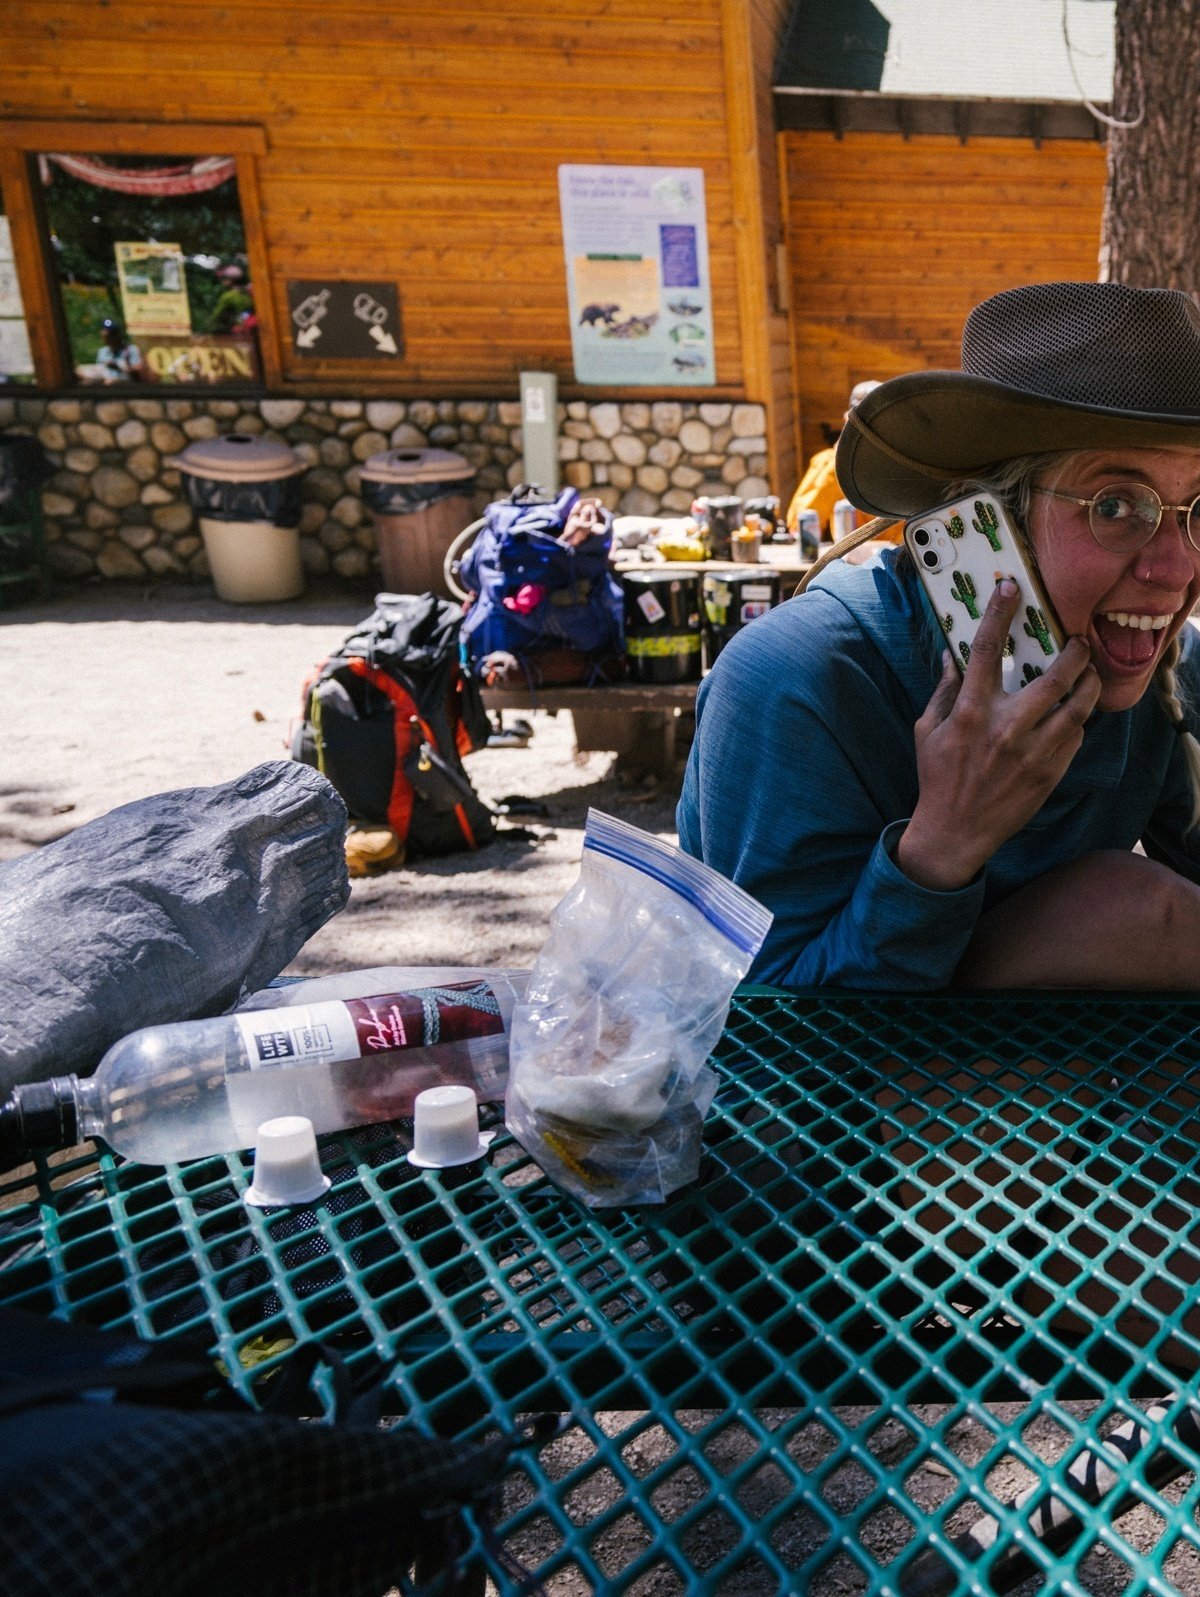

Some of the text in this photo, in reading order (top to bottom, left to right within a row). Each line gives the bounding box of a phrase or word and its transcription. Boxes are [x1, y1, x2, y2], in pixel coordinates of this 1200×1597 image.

[146, 346, 254, 378] OPEN
[261, 1034, 276, 1058] LIFE
[274, 1032, 289, 1057] WTR
